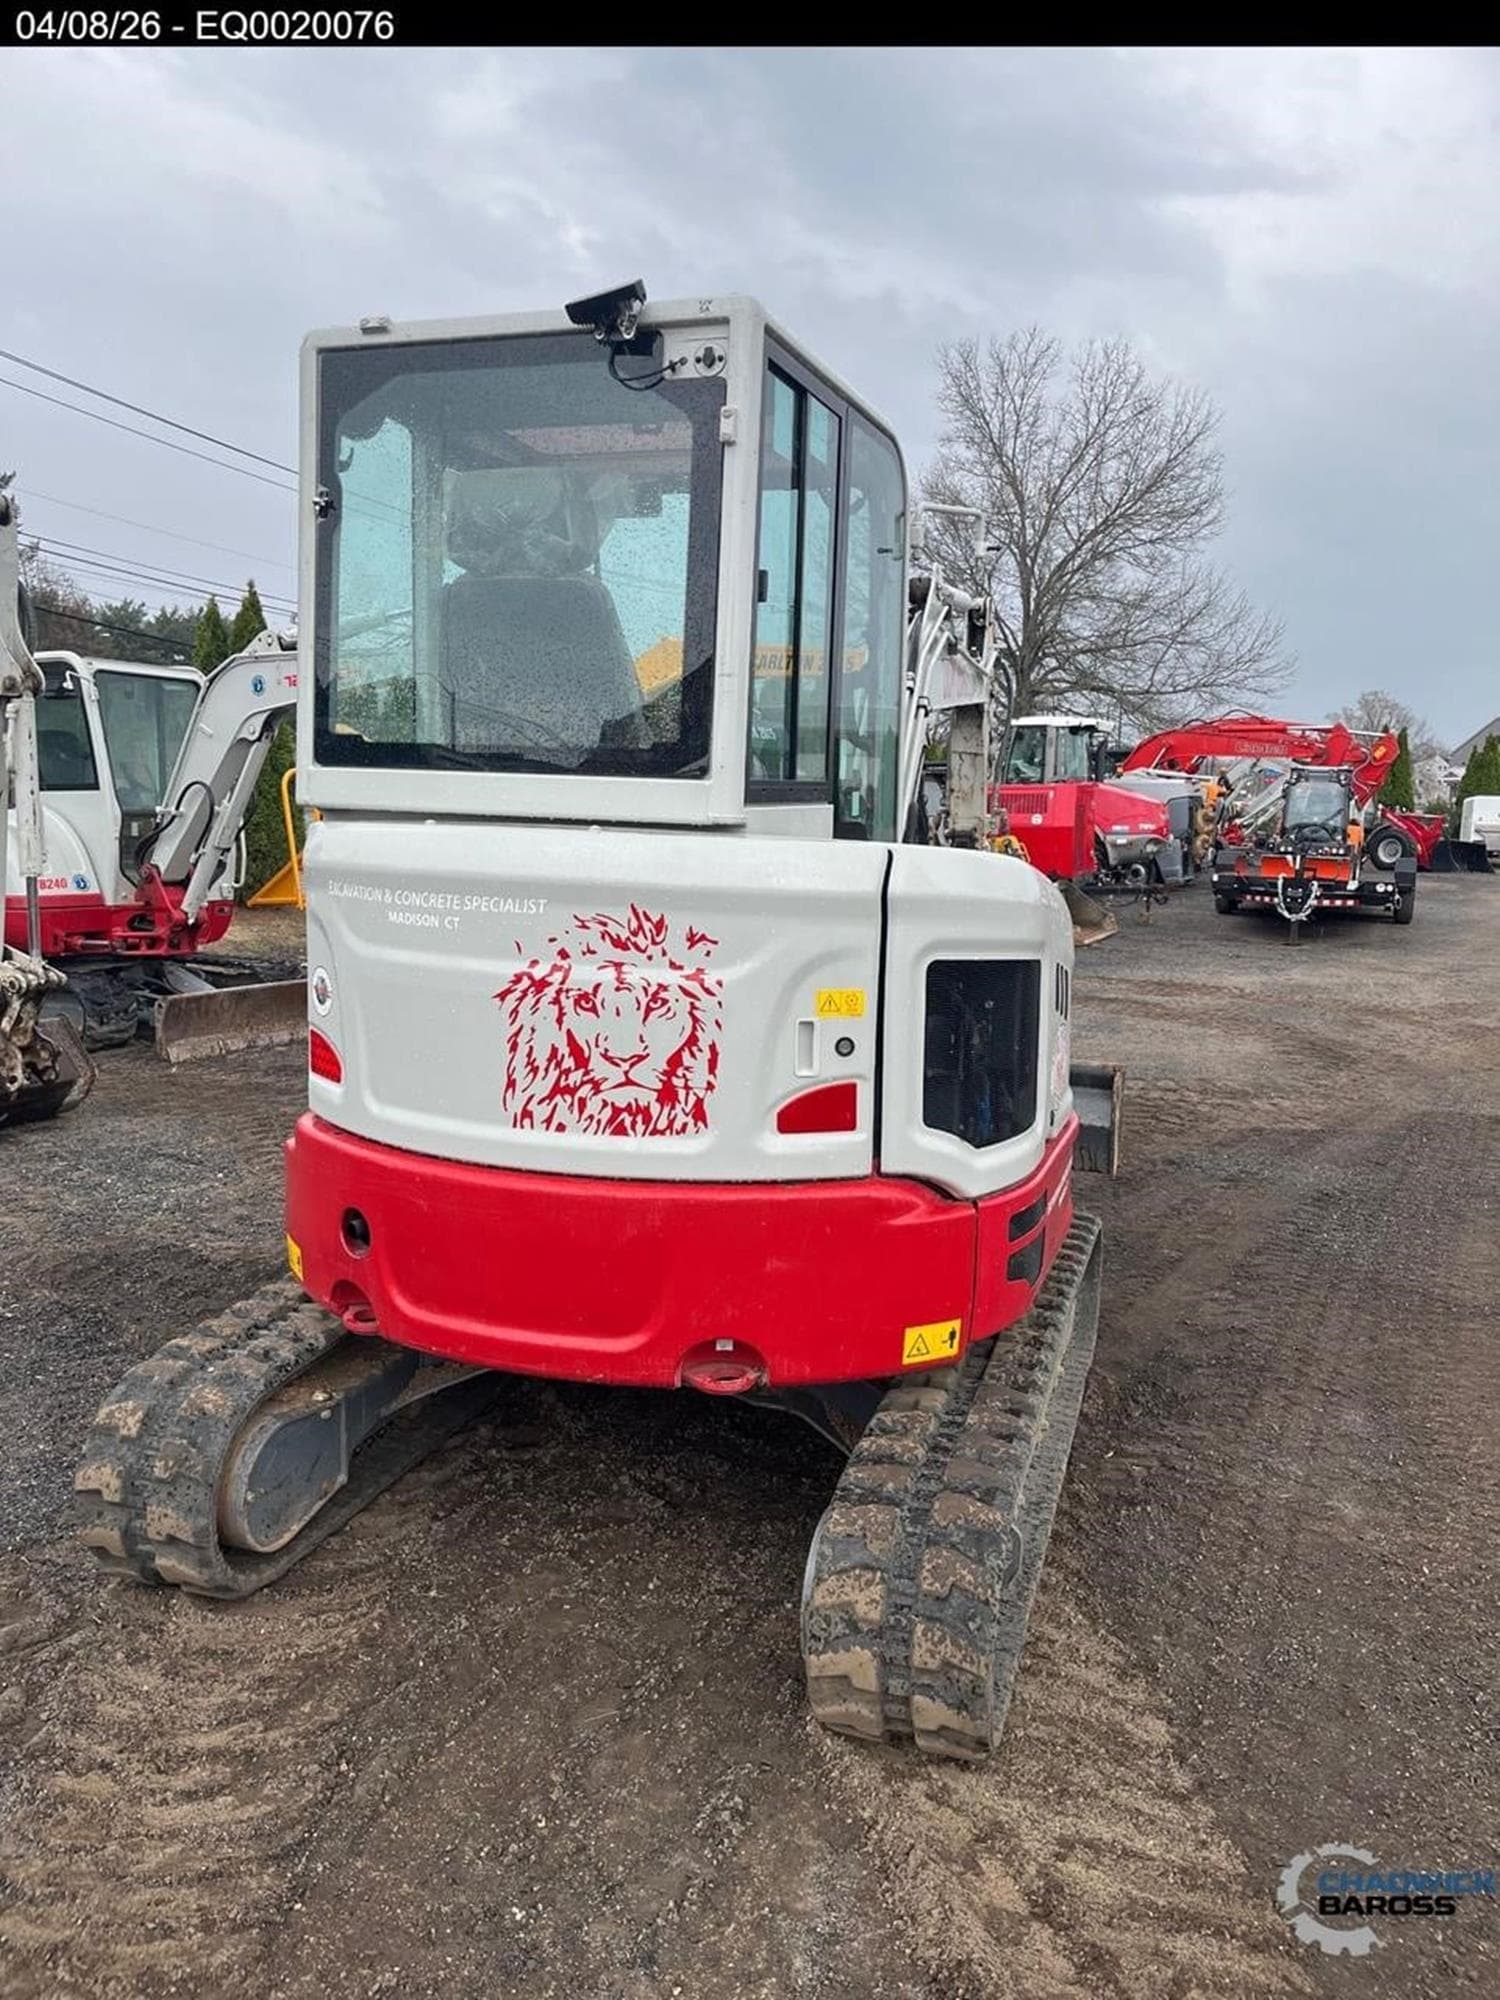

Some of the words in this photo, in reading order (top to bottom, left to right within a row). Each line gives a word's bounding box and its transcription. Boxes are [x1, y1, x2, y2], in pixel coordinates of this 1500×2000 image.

[752, 652, 816, 671] CARLTN
[384, 888, 393, 904] &
[394, 889, 461, 910] CONCRETE
[463, 895, 548, 914] SPECIALIST
[388, 911, 439, 928] MADISON
[444, 916, 460, 930] CT
